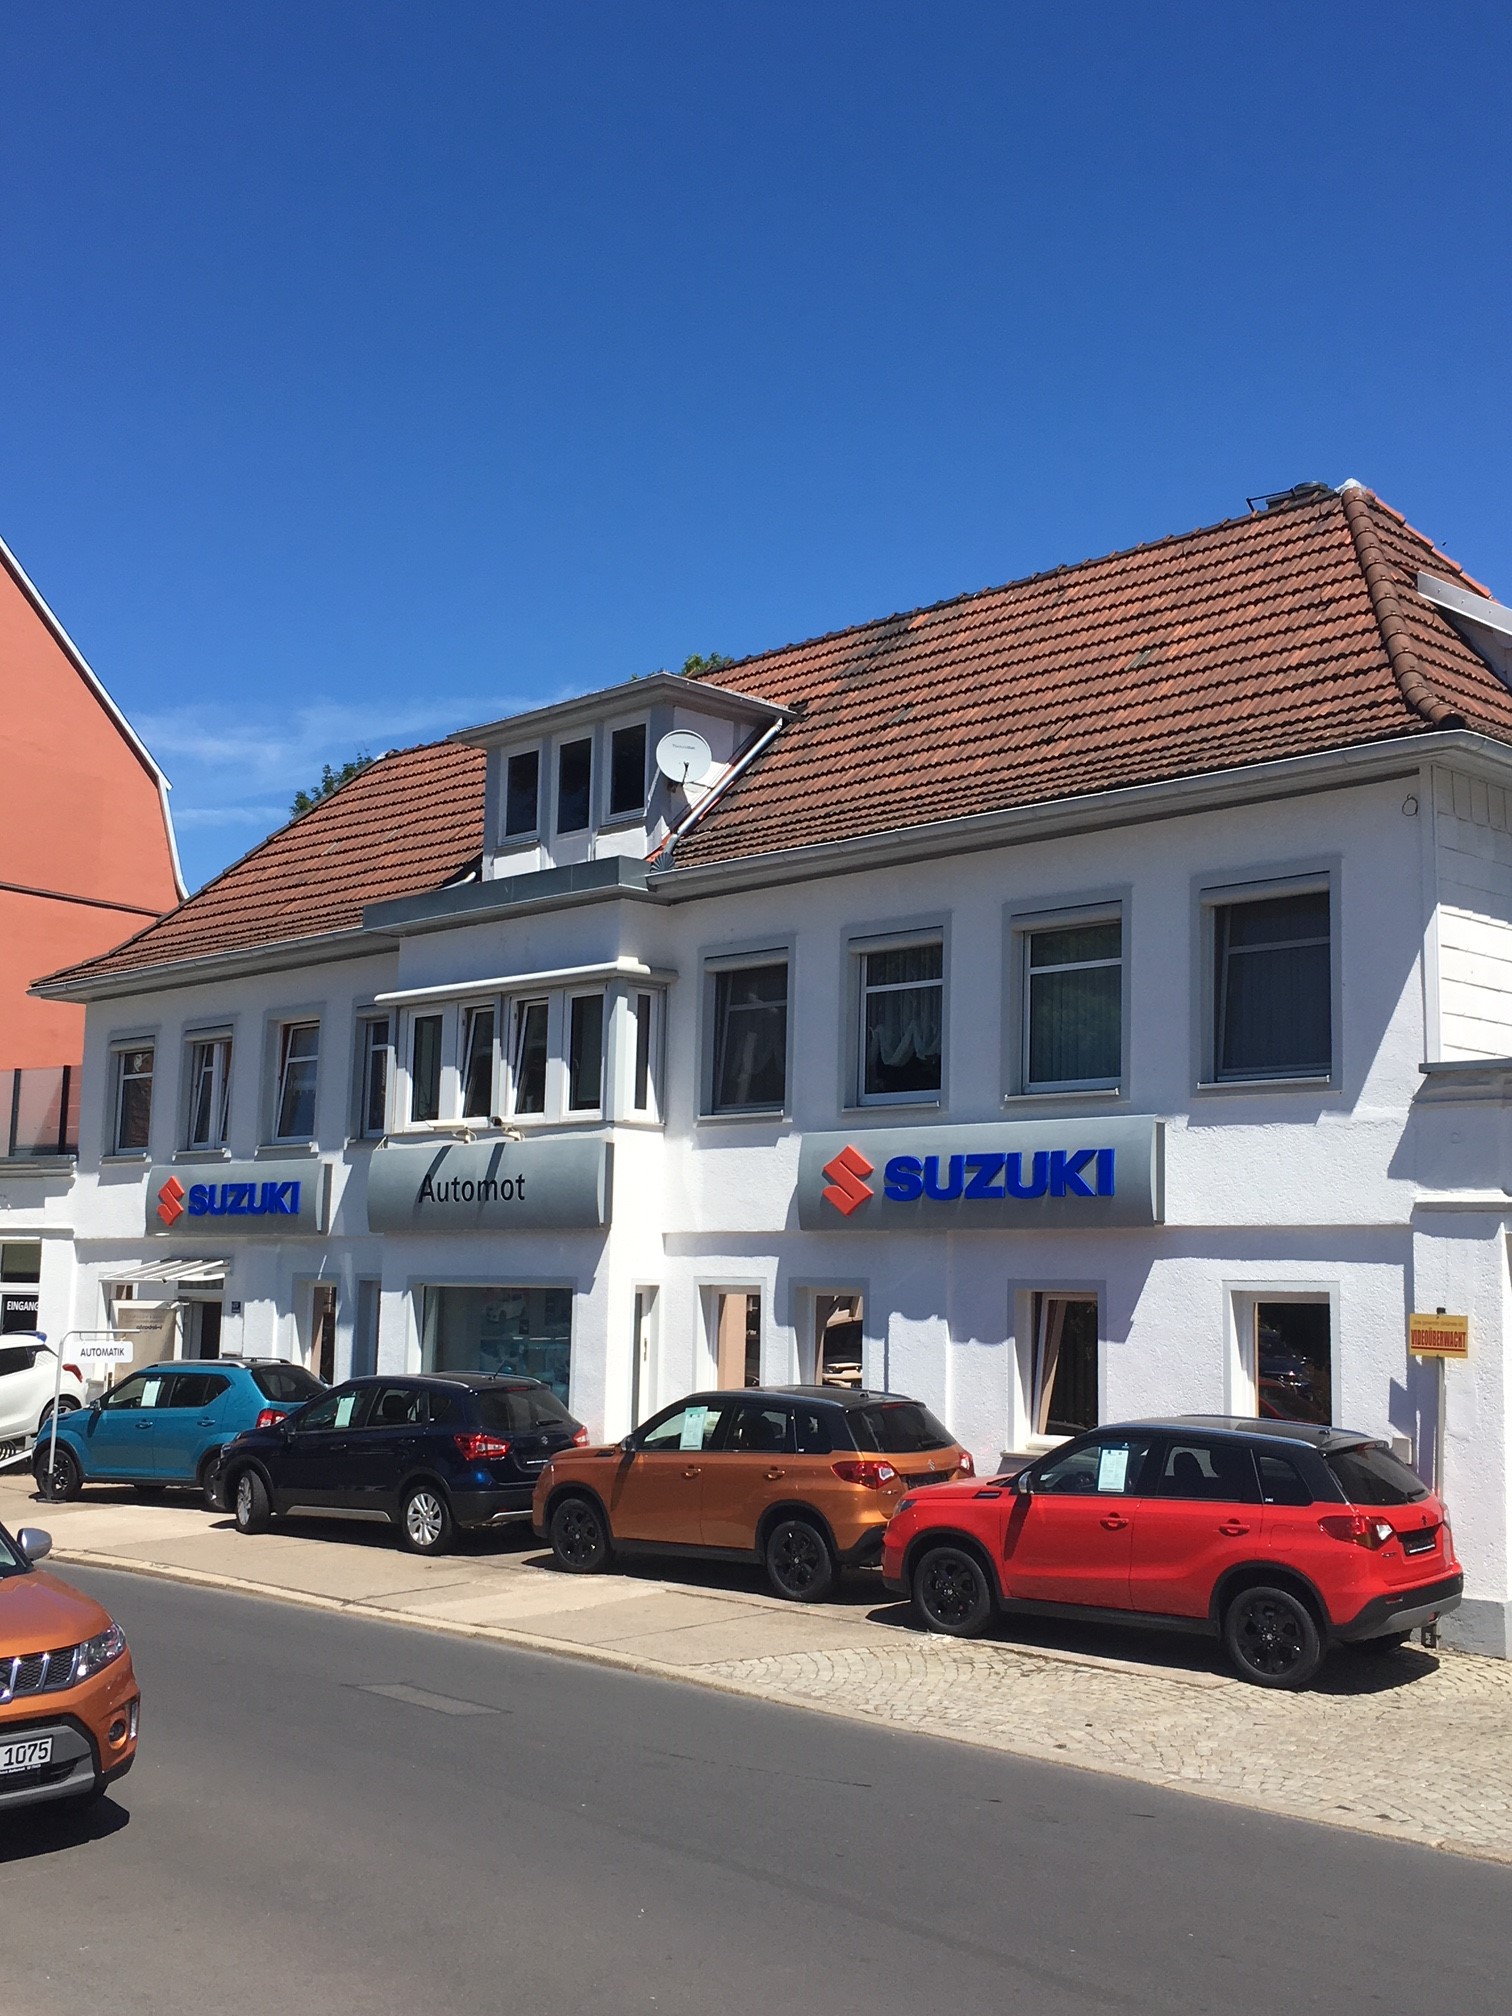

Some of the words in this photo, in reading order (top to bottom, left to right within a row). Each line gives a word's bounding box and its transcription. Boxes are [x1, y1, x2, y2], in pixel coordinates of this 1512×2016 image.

[418, 1173, 525, 1203] Automot
[884, 1148, 1115, 1201] SUZUKI
[188, 1181, 301, 1216] SUZUKI
[1411, 1327, 1466, 1347] VIDEOÜBERWACHT
[80, 1348, 125, 1357] AUTOMATIK
[4, 1741, 49, 1766] 1075
